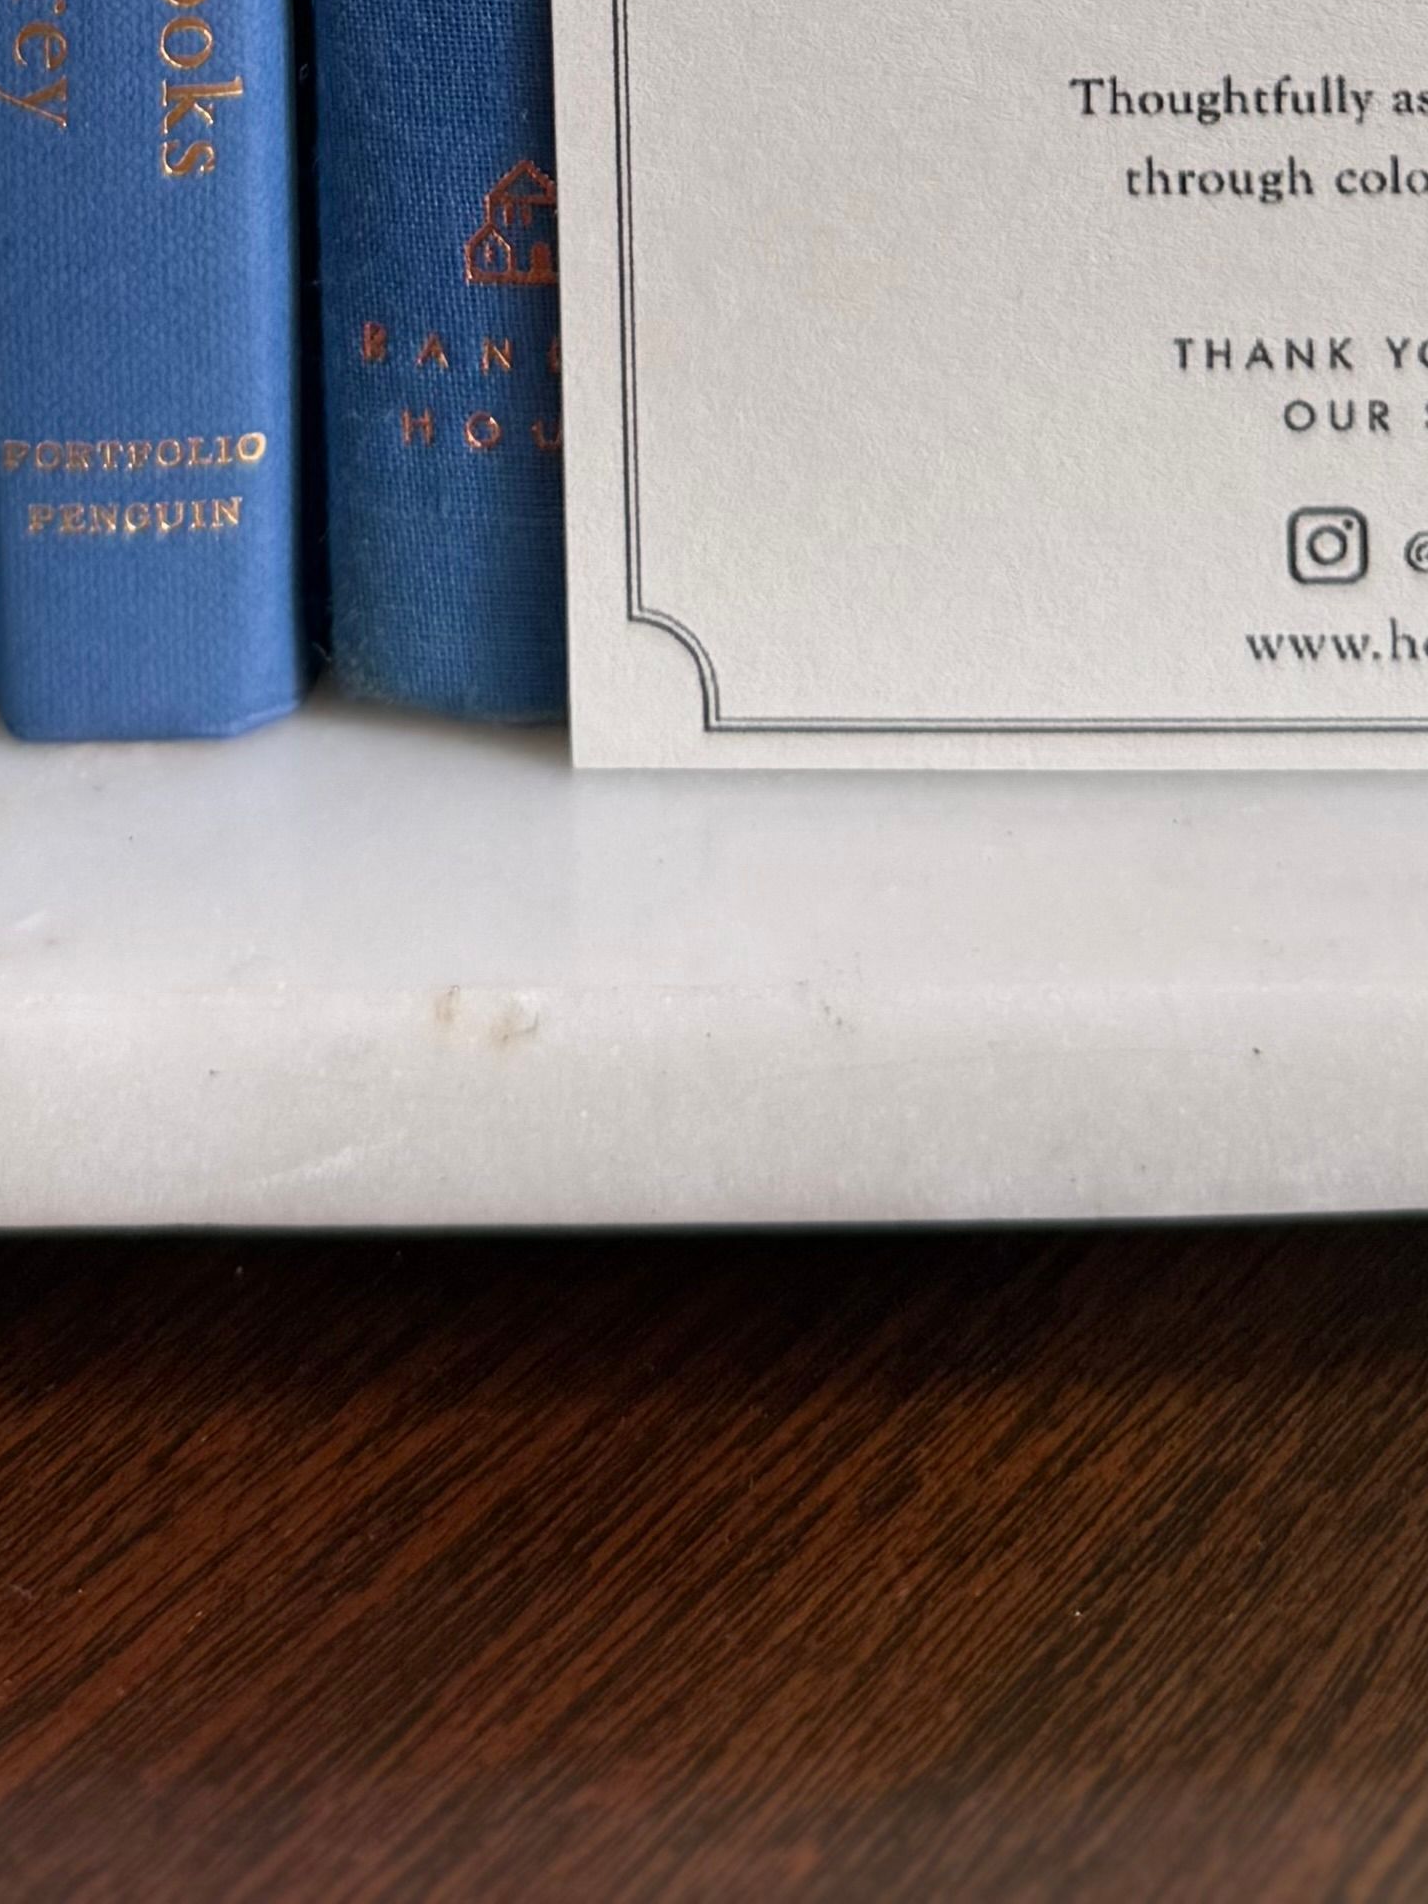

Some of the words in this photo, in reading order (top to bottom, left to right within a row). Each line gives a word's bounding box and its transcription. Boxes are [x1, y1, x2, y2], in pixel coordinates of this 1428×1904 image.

[1068, 73, 1375, 127] Thoughtfully
[1125, 154, 1315, 206] through
[1172, 336, 1354, 373] THANK
[1283, 398, 1391, 436] OUR
[2, 432, 266, 470] PORTFOLIO
[27, 496, 243, 534] PENGUIN
